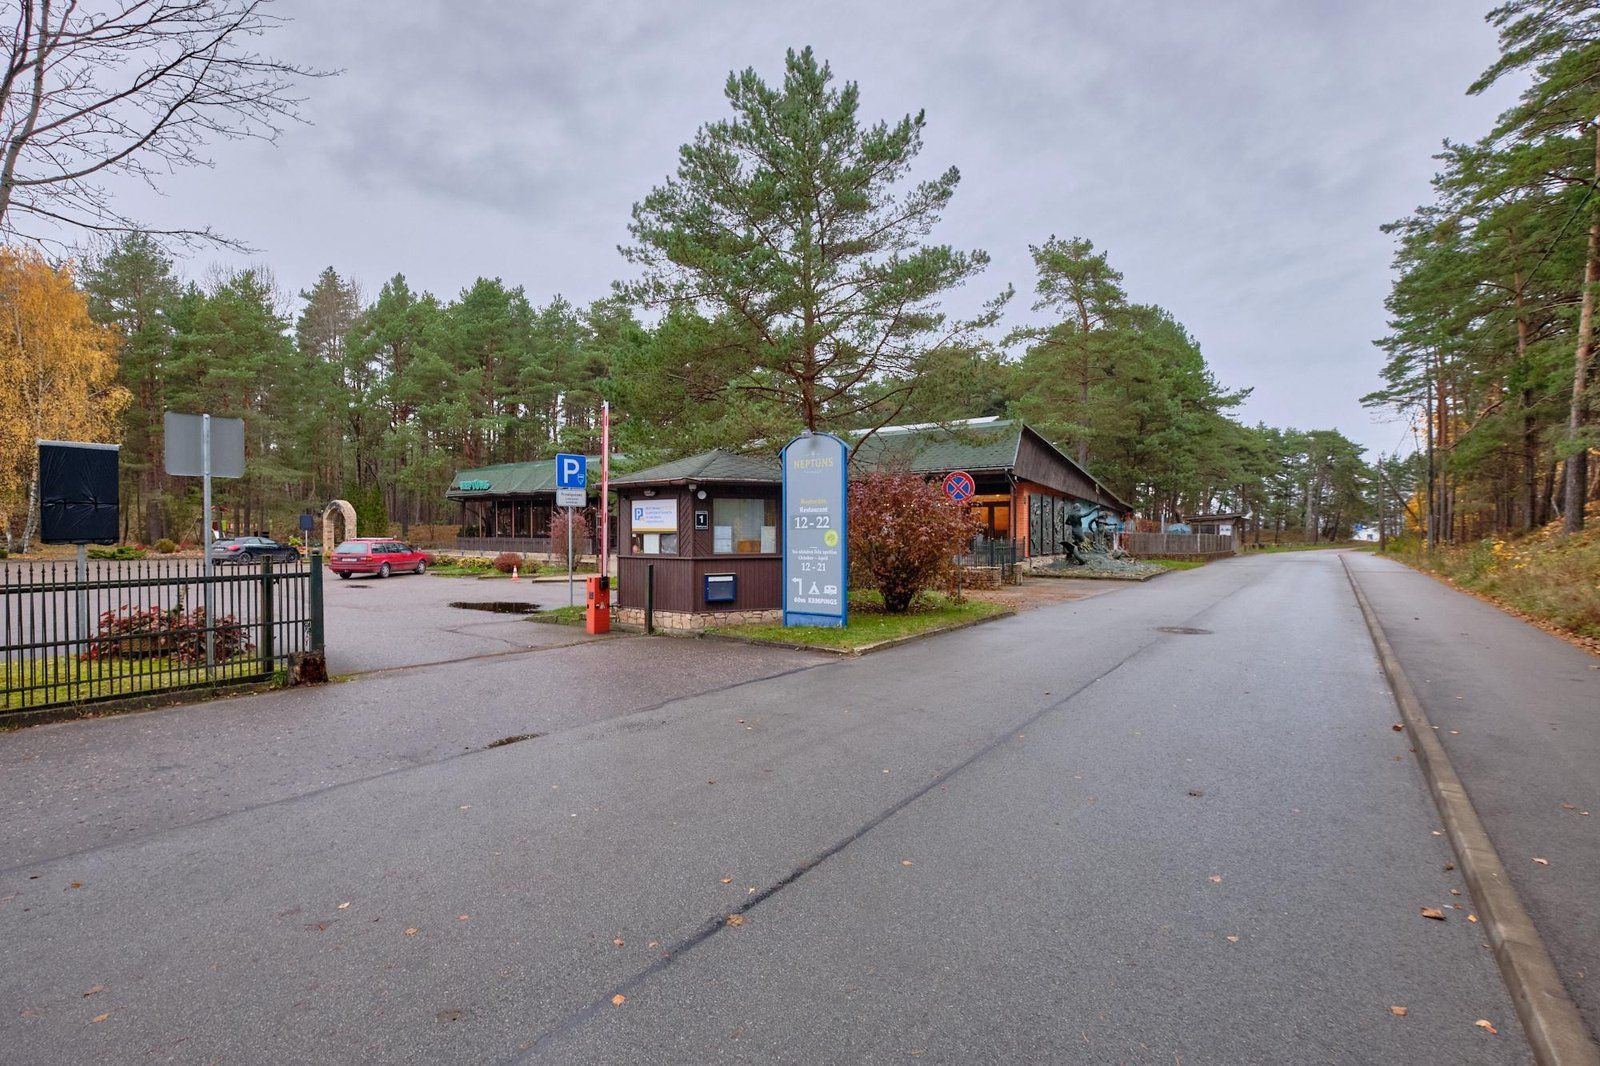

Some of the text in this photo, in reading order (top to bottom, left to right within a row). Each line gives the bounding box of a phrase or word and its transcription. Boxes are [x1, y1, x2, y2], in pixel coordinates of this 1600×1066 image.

[563, 458, 580, 484] P
[699, 515, 704, 524] 1
[794, 516, 809, 529] 12
[815, 516, 830, 529] 22
[801, 562, 811, 571] 12
[816, 562, 826, 571] 21
